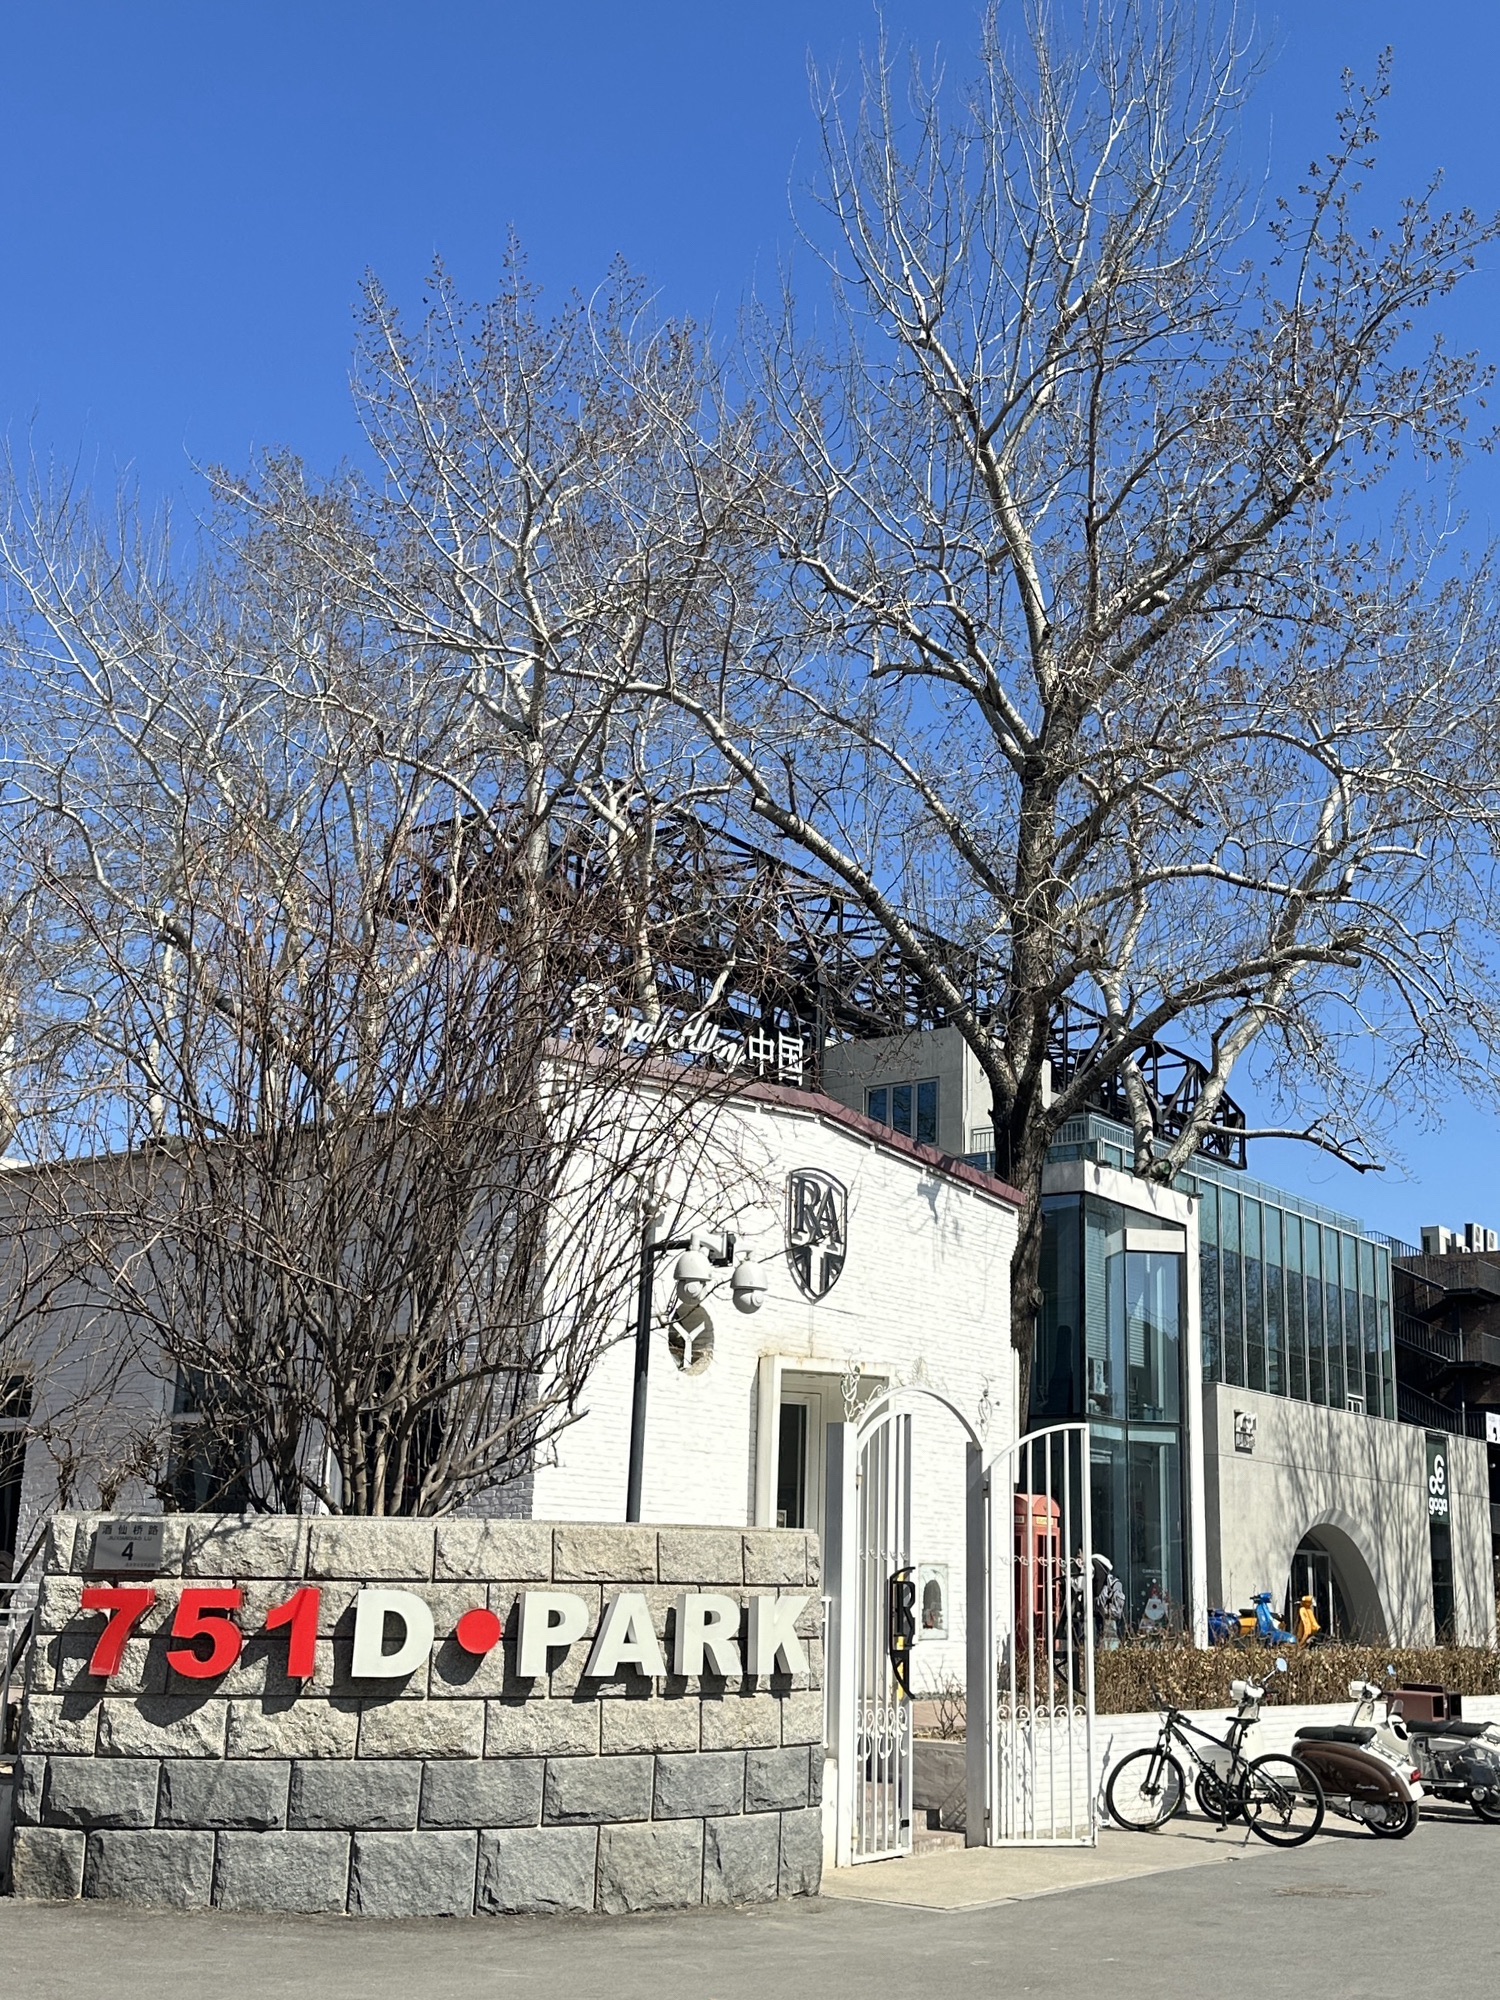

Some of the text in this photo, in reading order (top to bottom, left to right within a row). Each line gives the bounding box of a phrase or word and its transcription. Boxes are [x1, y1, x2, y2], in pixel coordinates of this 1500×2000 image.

[750, 1027, 804, 1086] 中国
[102, 1524, 158, 1535] 酒仙桥路
[121, 1541, 134, 1561] 4
[81, 1588, 320, 1679] 751
